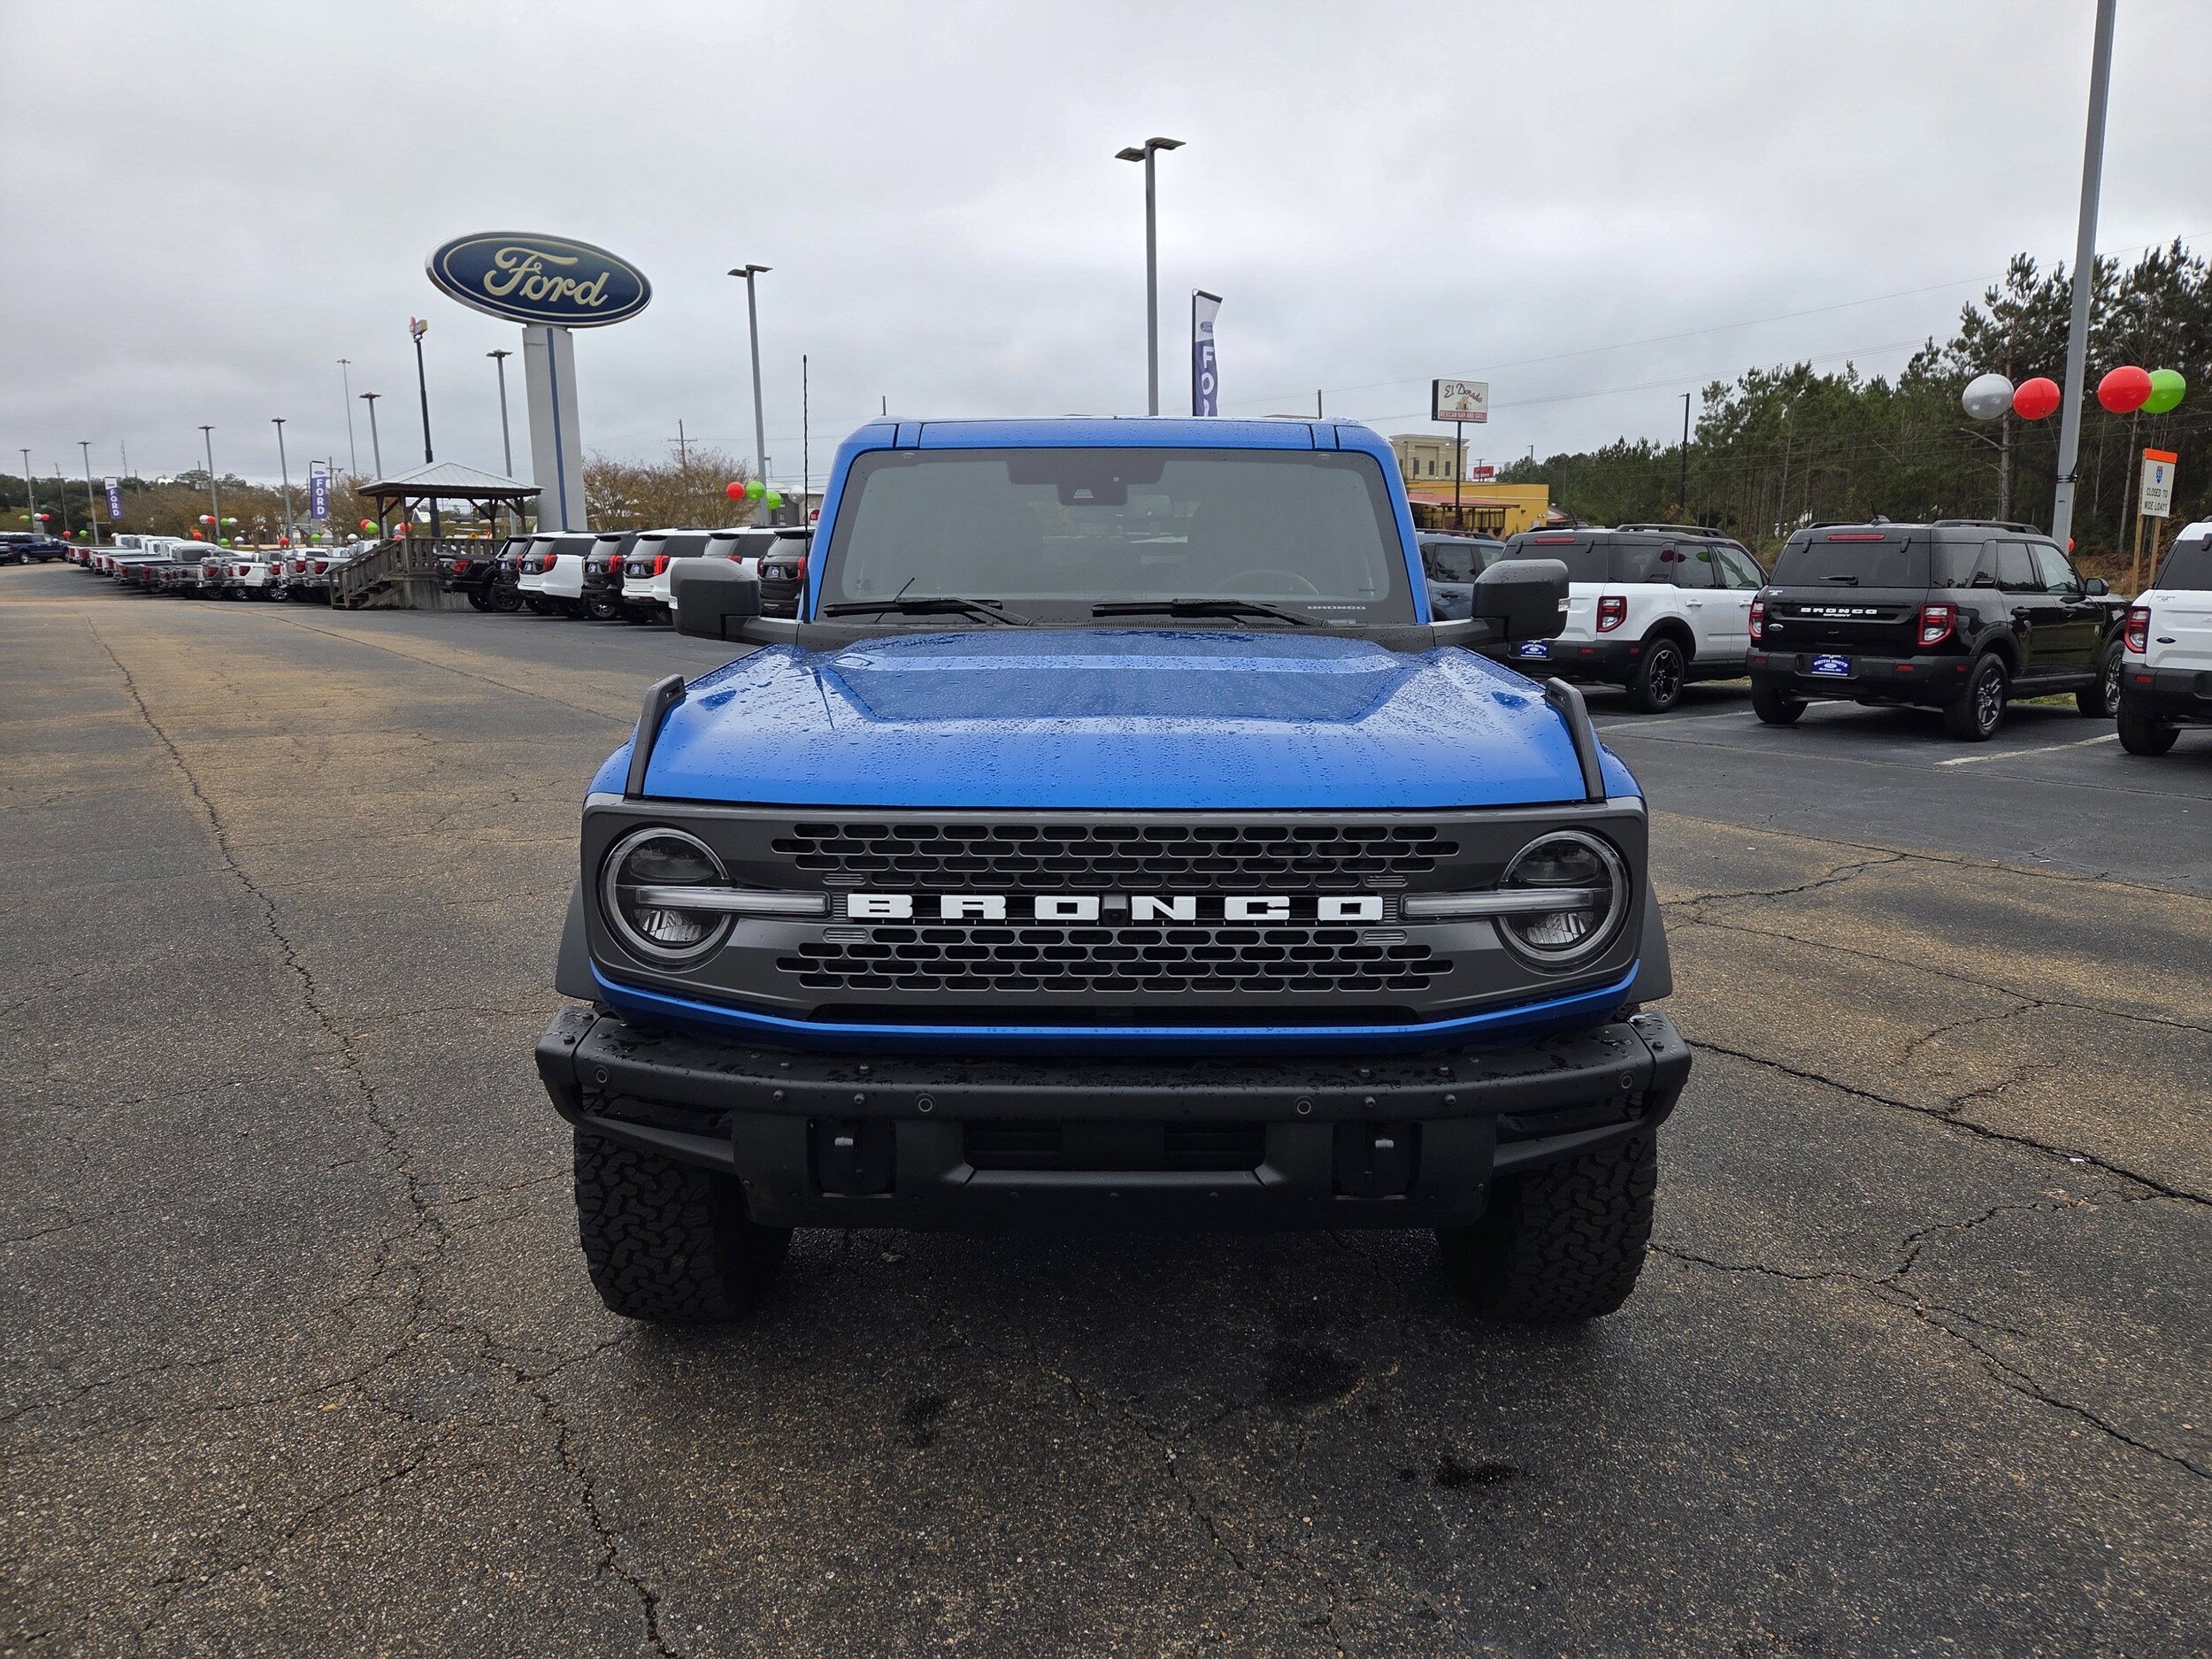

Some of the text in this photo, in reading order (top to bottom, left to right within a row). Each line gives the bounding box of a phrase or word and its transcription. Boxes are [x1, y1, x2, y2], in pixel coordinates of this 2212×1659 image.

[483, 247, 611, 307] Ford
[1444, 382, 1483, 403] El Dorado
[110, 488, 119, 517] FORD
[316, 479, 326, 515] FORD
[2144, 500, 2169, 511] WIDE LOADS
[2147, 487, 2169, 498] CLOSED TO
[847, 893, 1384, 921] BRONCO
